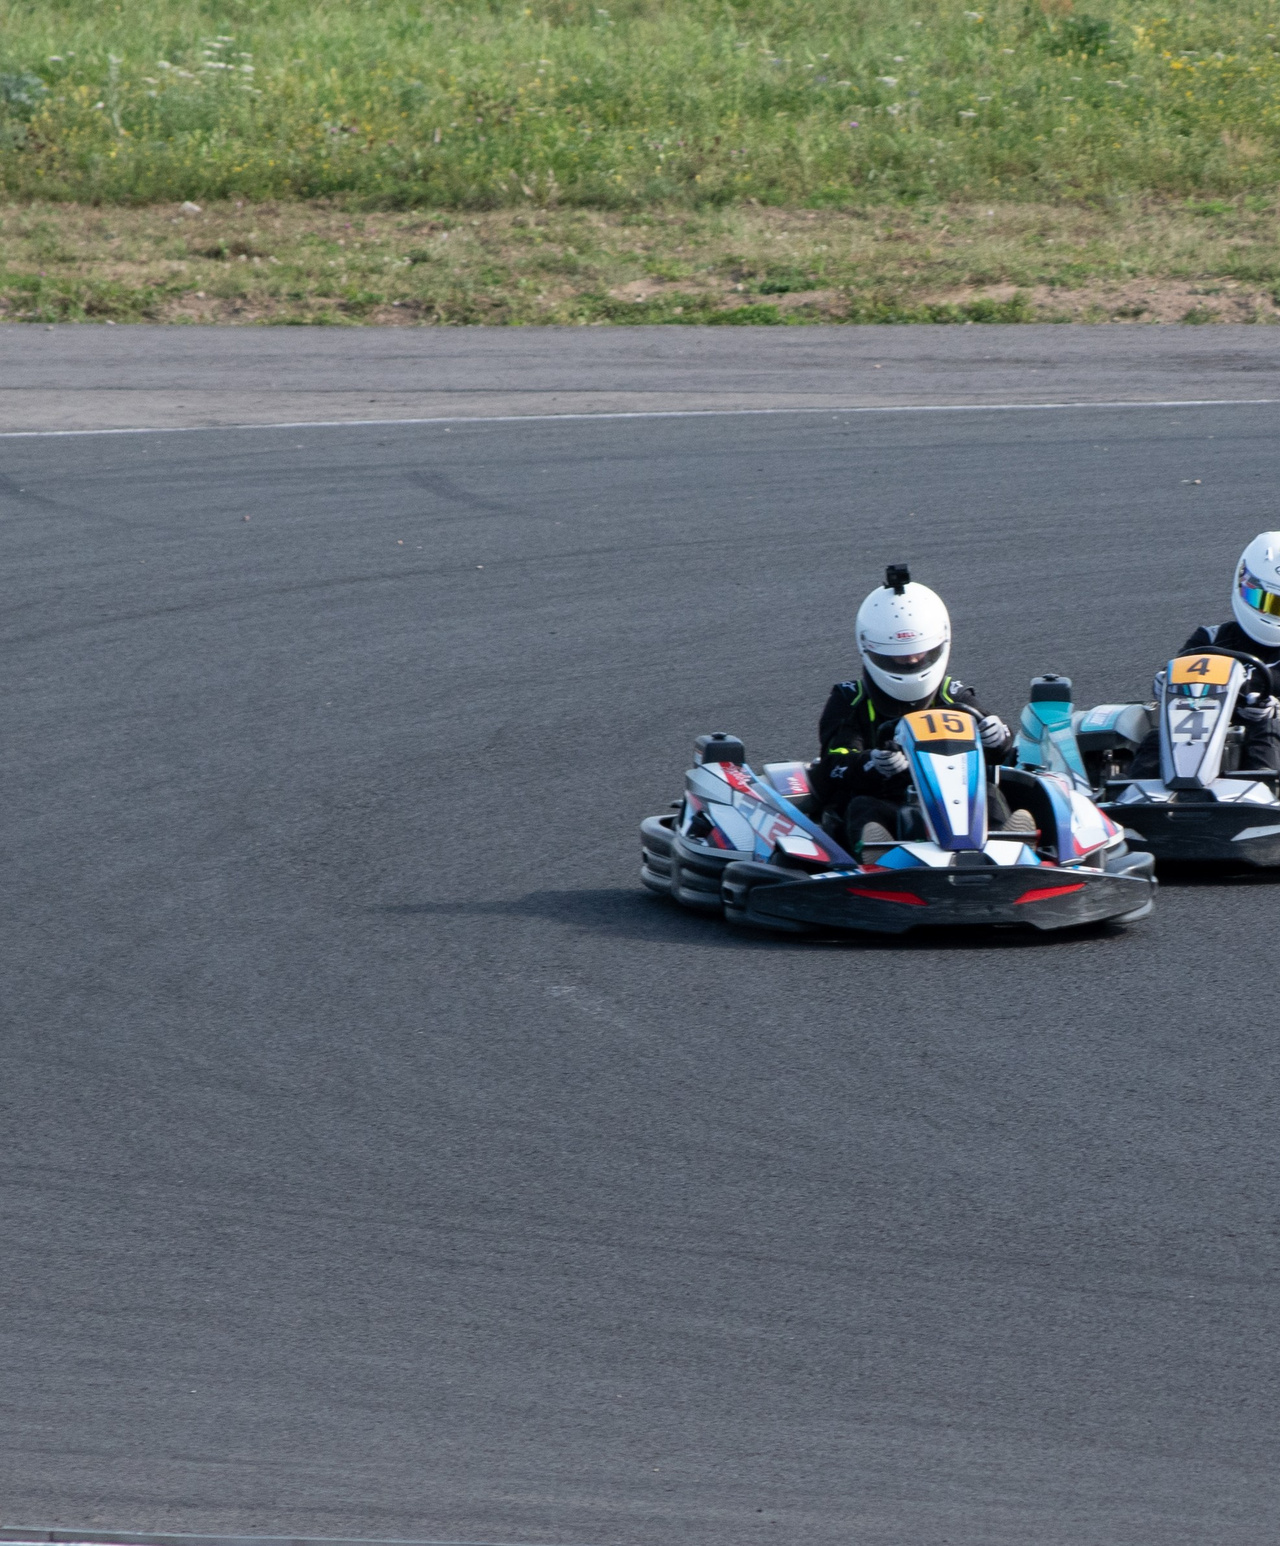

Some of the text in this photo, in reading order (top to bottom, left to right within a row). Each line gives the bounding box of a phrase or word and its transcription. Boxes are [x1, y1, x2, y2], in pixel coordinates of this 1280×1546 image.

[1186, 657, 1211, 676] 4
[920, 713, 965, 734] 15
[1174, 711, 1210, 740] 4
